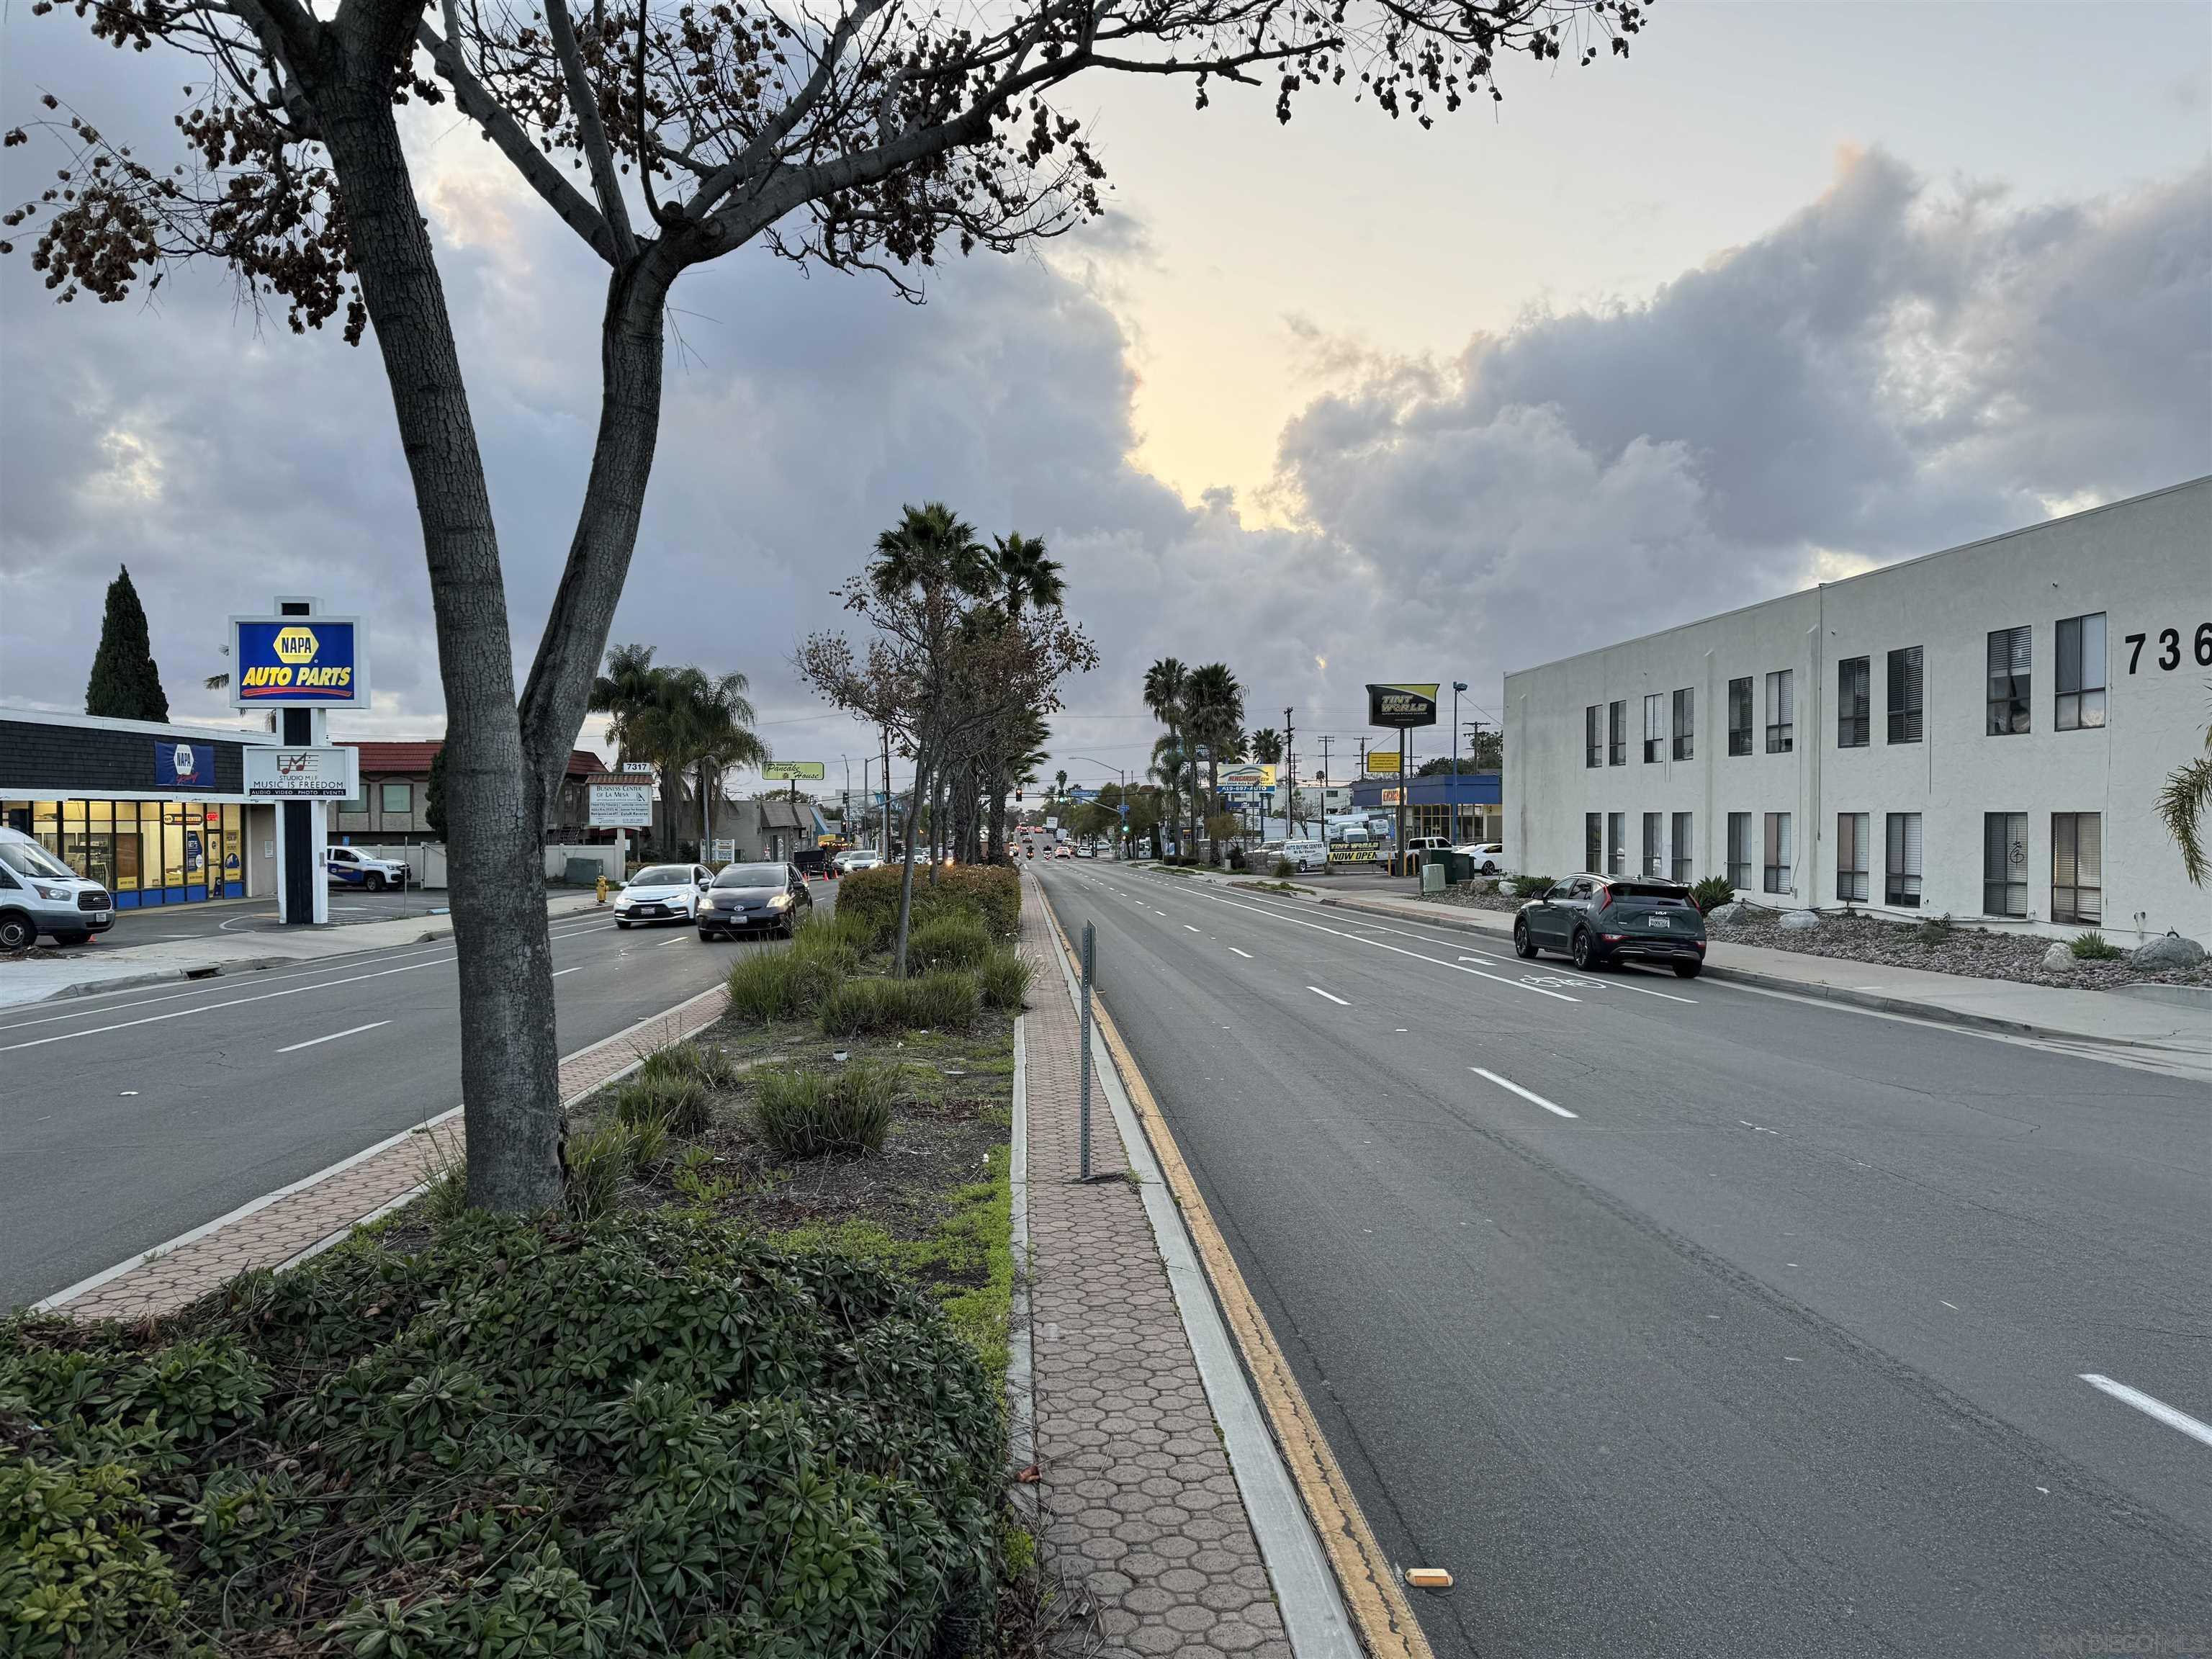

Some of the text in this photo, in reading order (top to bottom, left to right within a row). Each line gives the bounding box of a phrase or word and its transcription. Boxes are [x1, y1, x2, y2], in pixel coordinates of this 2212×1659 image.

[282, 637, 312, 653] NAPA
[2125, 622, 2212, 675] 736
[242, 667, 351, 685] AUTO PARTS
[1382, 703, 1428, 712] WORLD
[177, 752, 191, 766] NAPA
[765, 763, 800, 772] Pancake
